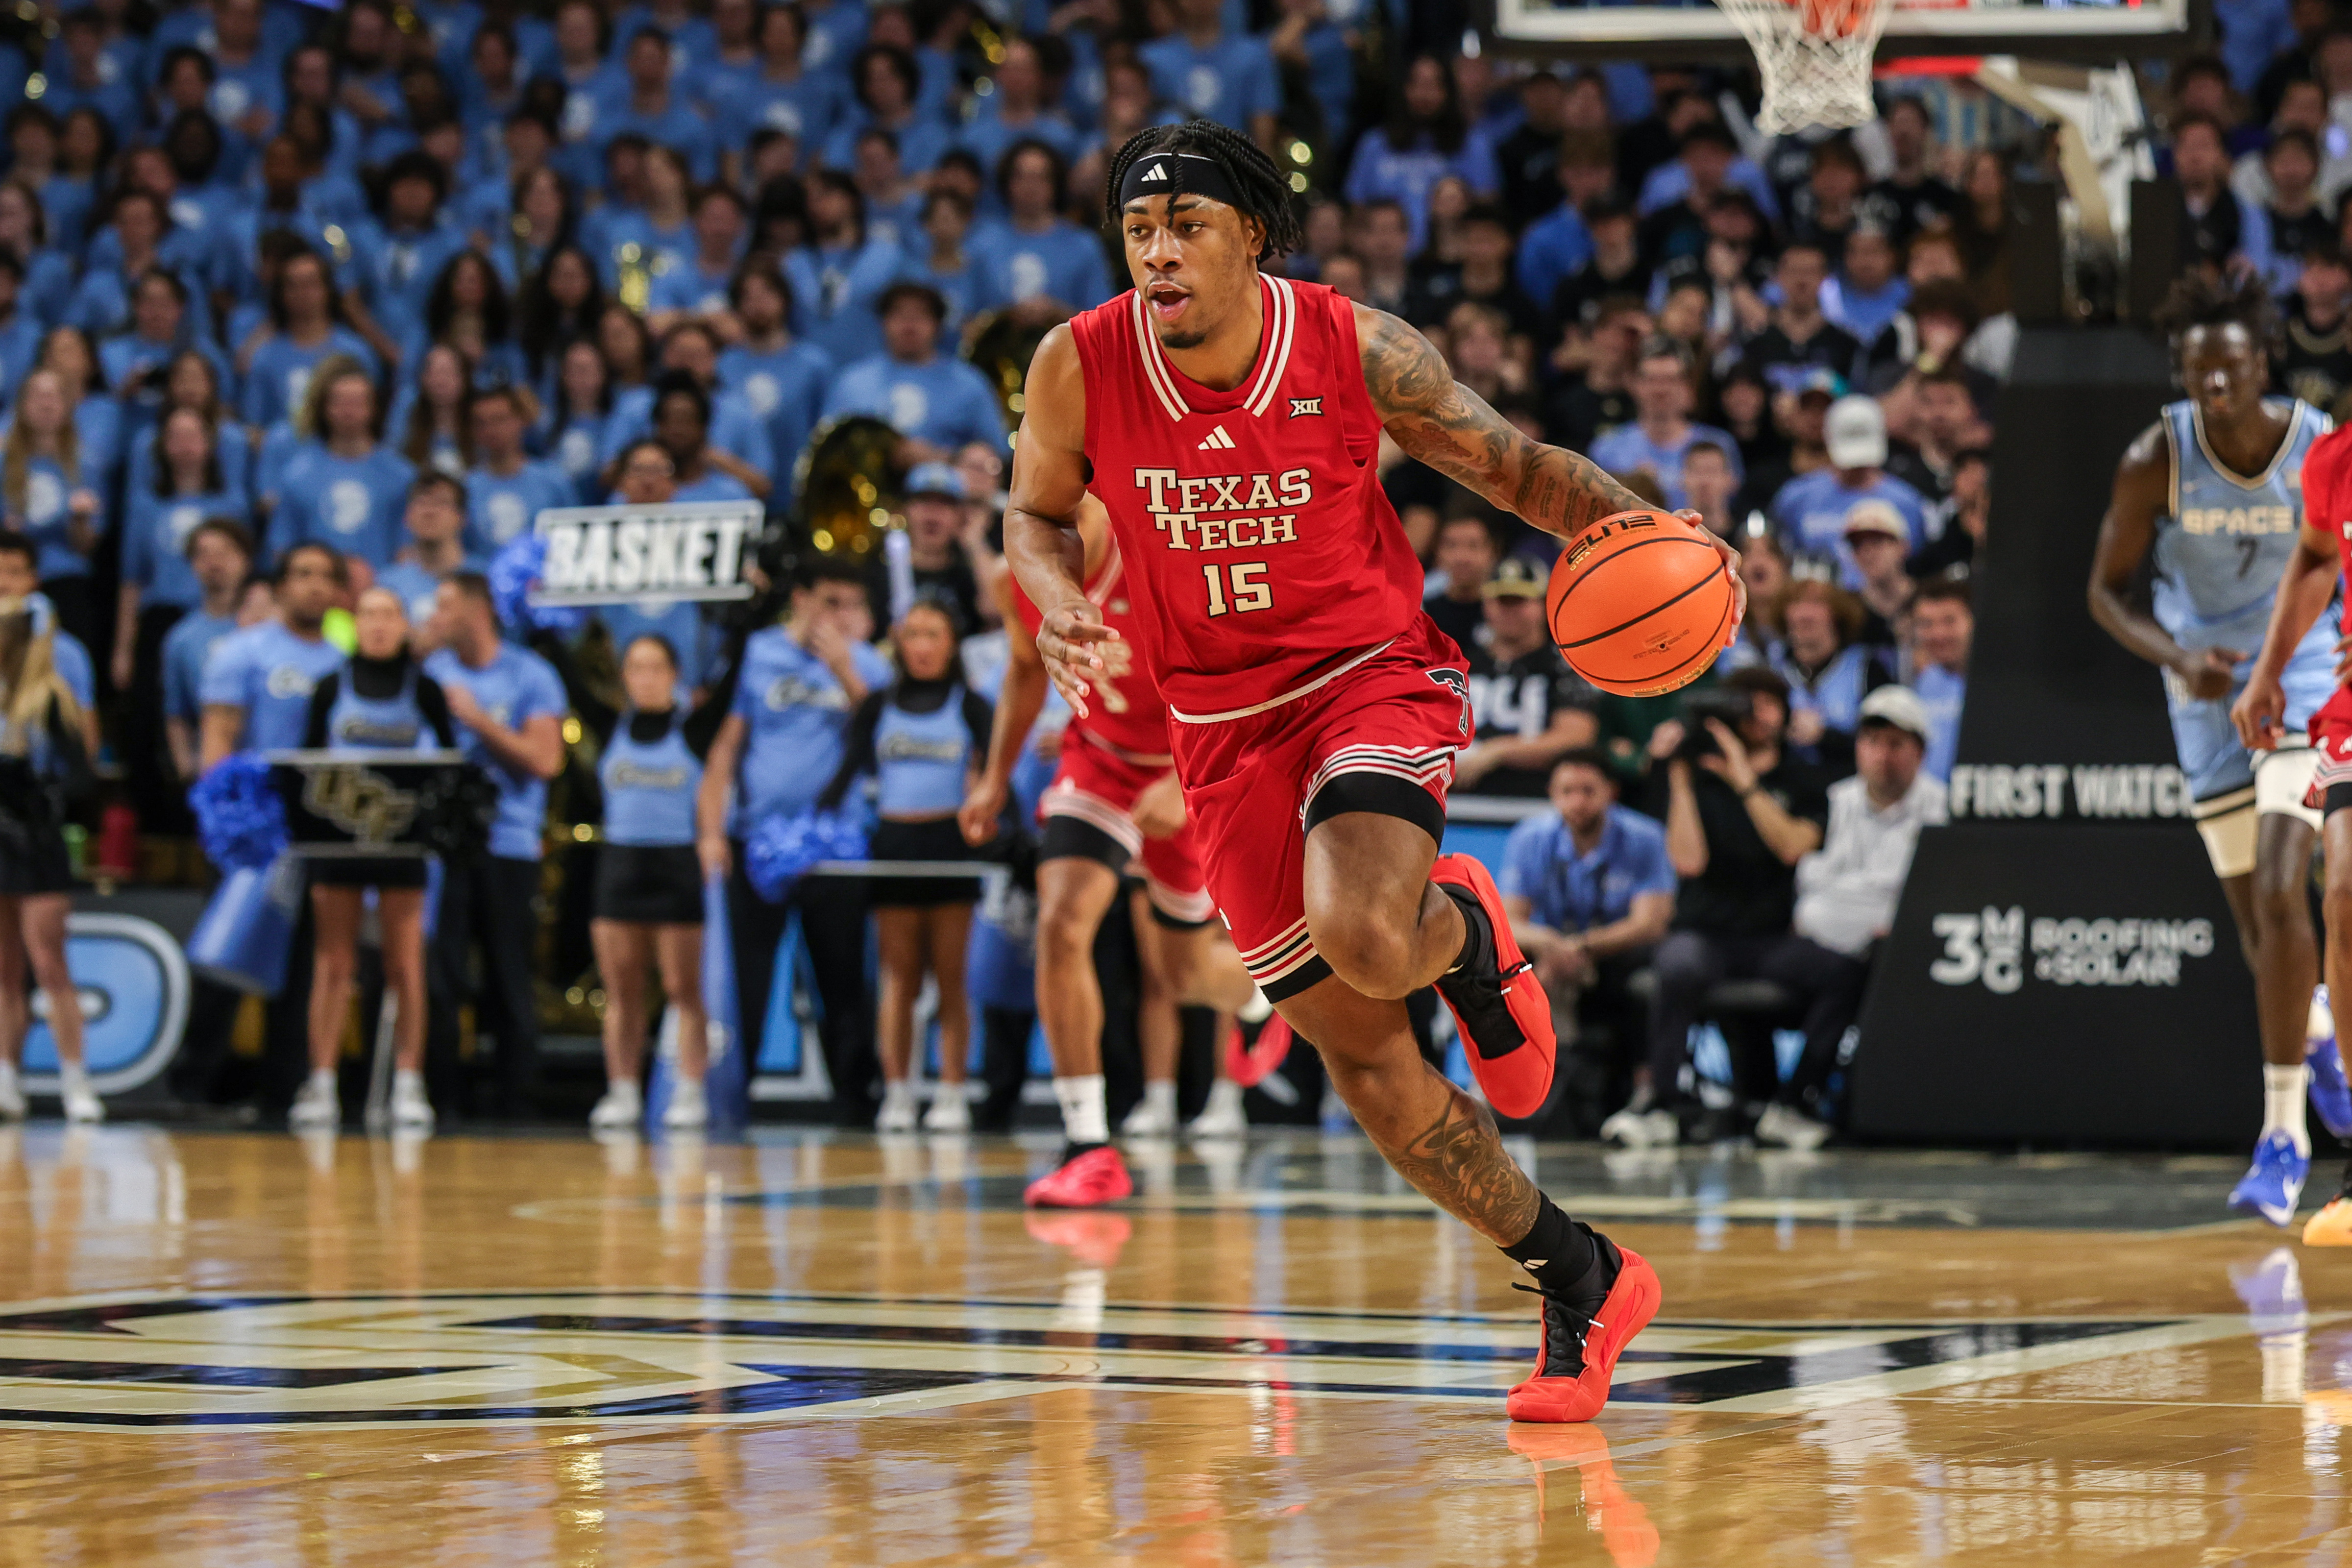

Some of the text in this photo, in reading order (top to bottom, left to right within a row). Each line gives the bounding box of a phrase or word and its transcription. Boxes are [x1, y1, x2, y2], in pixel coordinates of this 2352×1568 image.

[1289, 397, 1323, 419] XII
[1155, 513, 1298, 551] TECH
[1565, 515, 1657, 565] ELITE
[2181, 507, 2295, 536] SPACE
[545, 517, 744, 589] BASKET
[2236, 537, 2258, 580] 7
[1203, 563, 1273, 616] 15
[1951, 762, 2068, 819] FIRST
[2031, 917, 2215, 957] ROOFING
